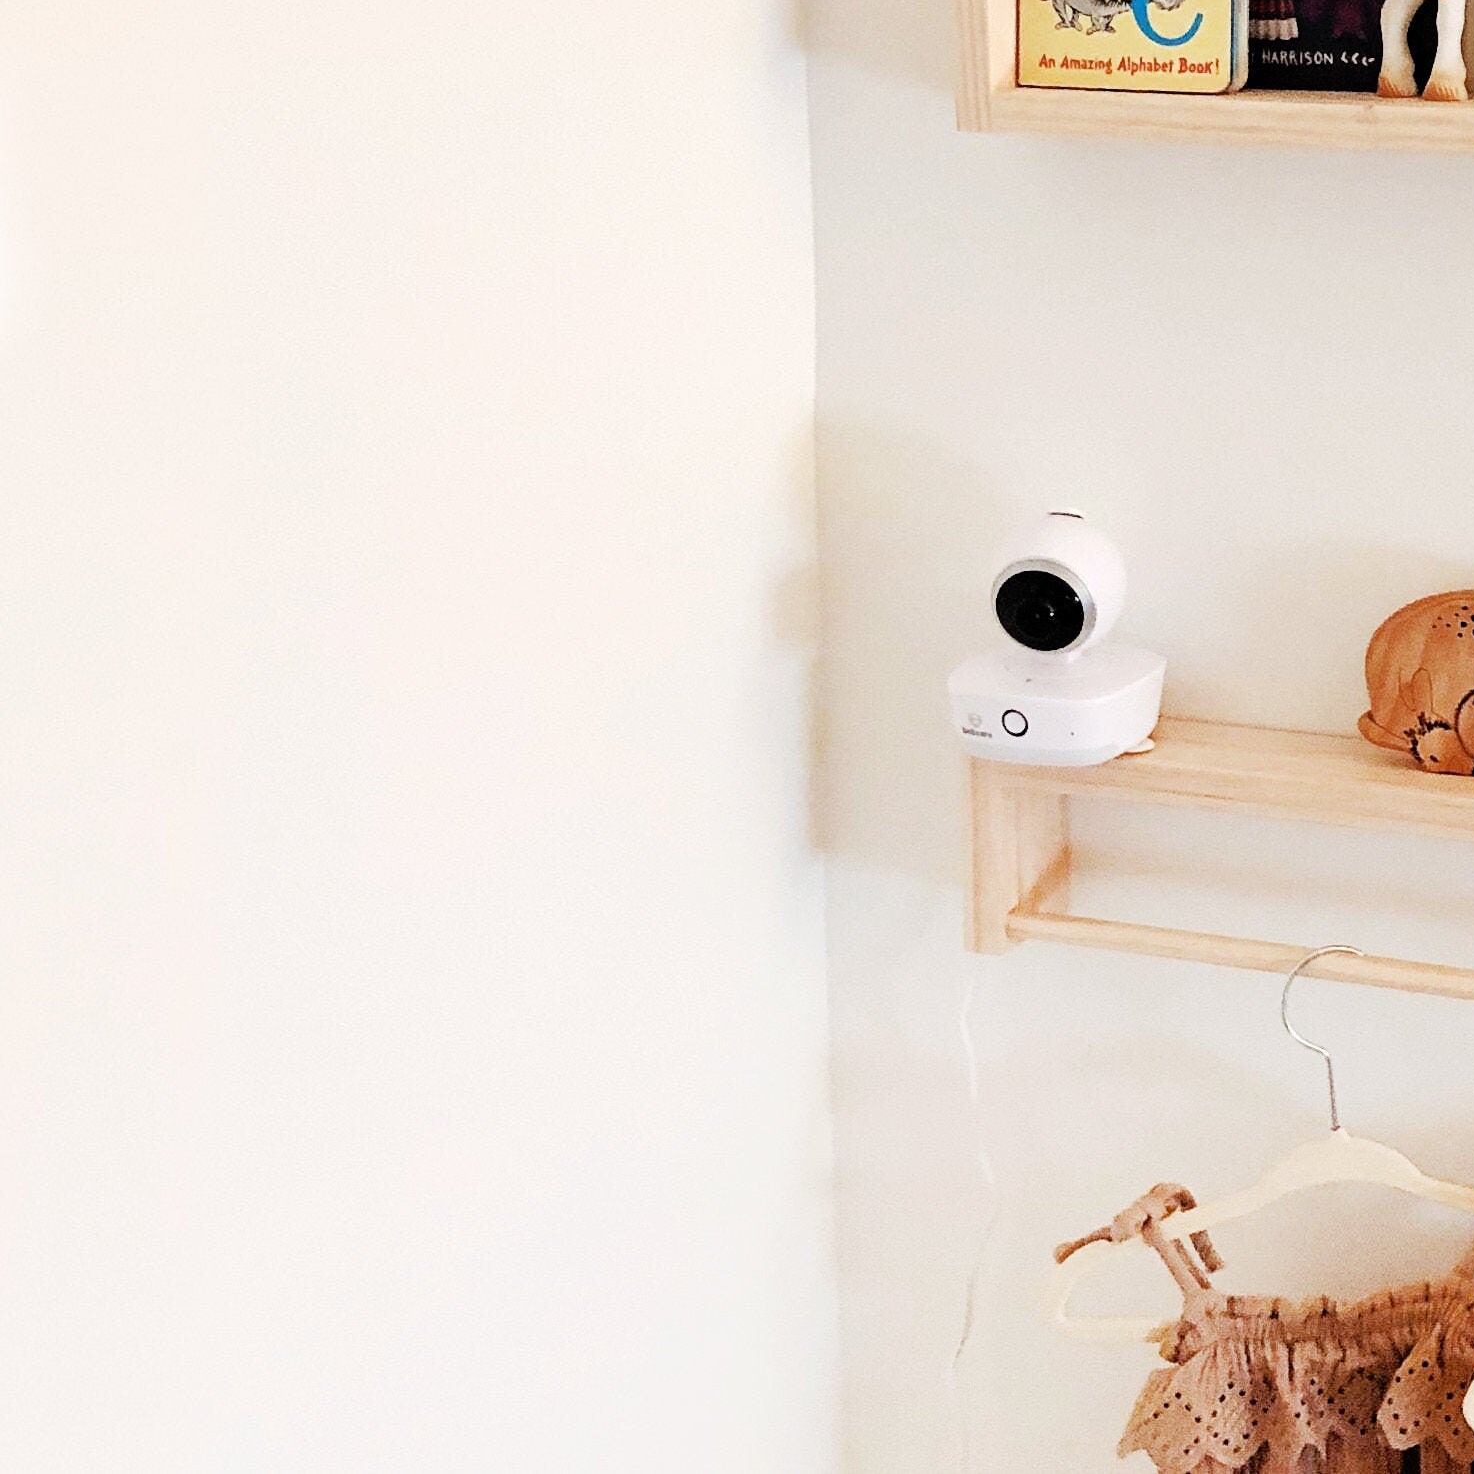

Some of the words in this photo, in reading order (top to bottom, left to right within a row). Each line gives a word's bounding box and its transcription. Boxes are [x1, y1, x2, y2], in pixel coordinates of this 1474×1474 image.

[1038, 53, 1056, 69] An
[1060, 55, 1113, 75] Amazing
[1117, 55, 1174, 76] Alphabet
[1261, 48, 1334, 66] HARRISON
